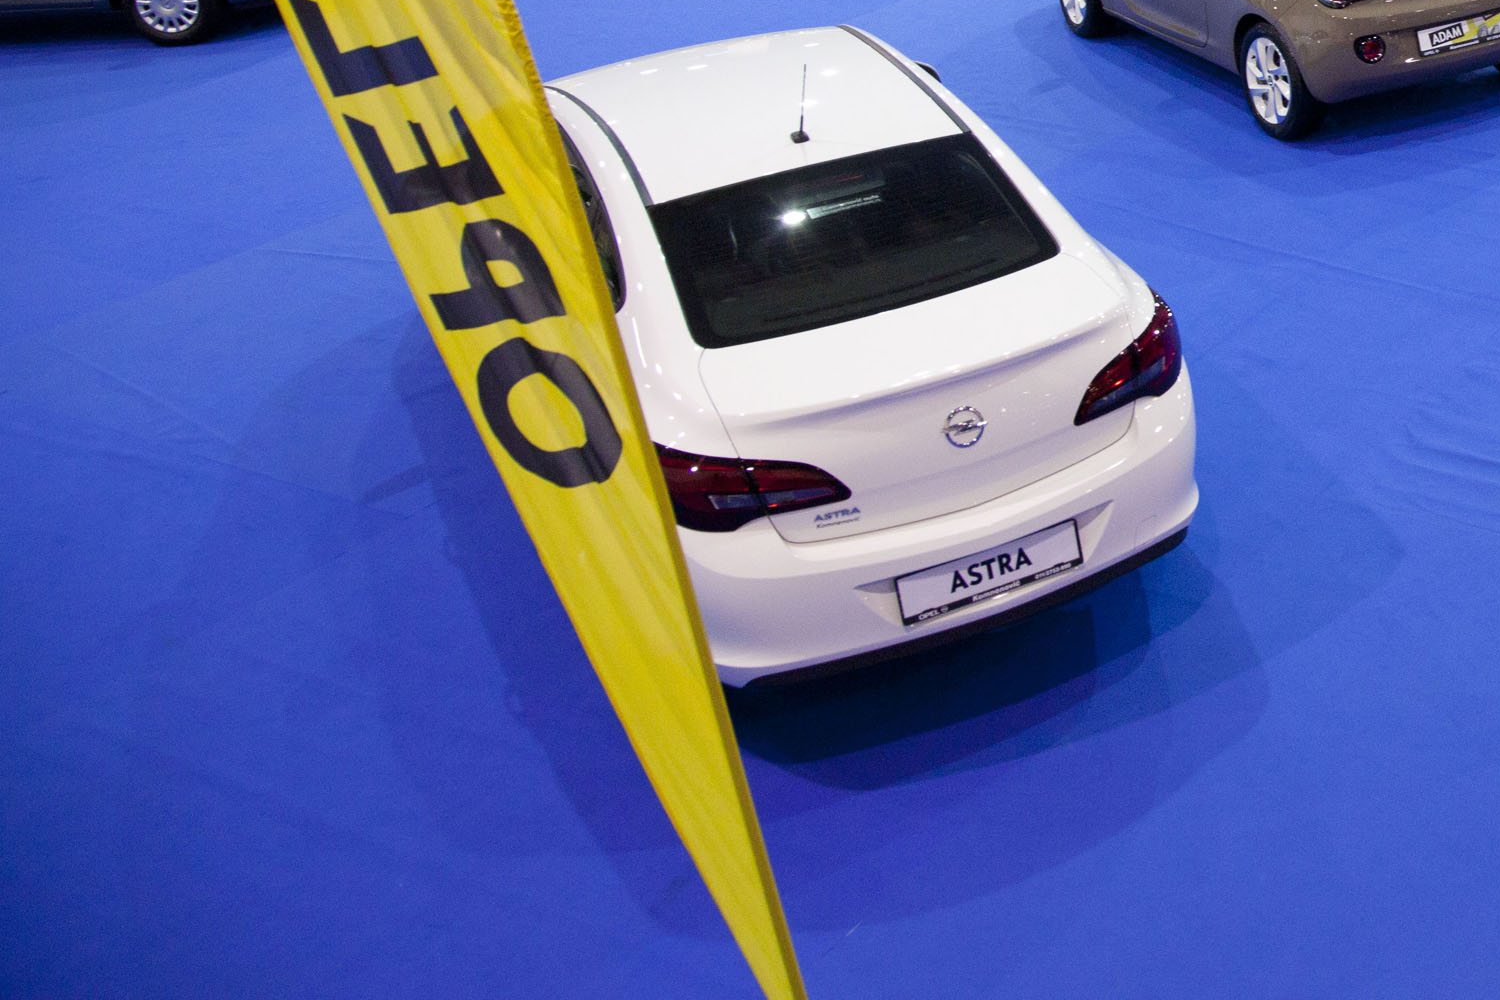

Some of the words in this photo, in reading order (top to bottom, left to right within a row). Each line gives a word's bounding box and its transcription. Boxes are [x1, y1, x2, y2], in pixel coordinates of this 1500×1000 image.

[1432, 25, 1463, 45] ADAM
[814, 507, 861, 521] ASTRA
[951, 548, 1032, 594] ASTRA
[917, 609, 939, 622] OPEL
